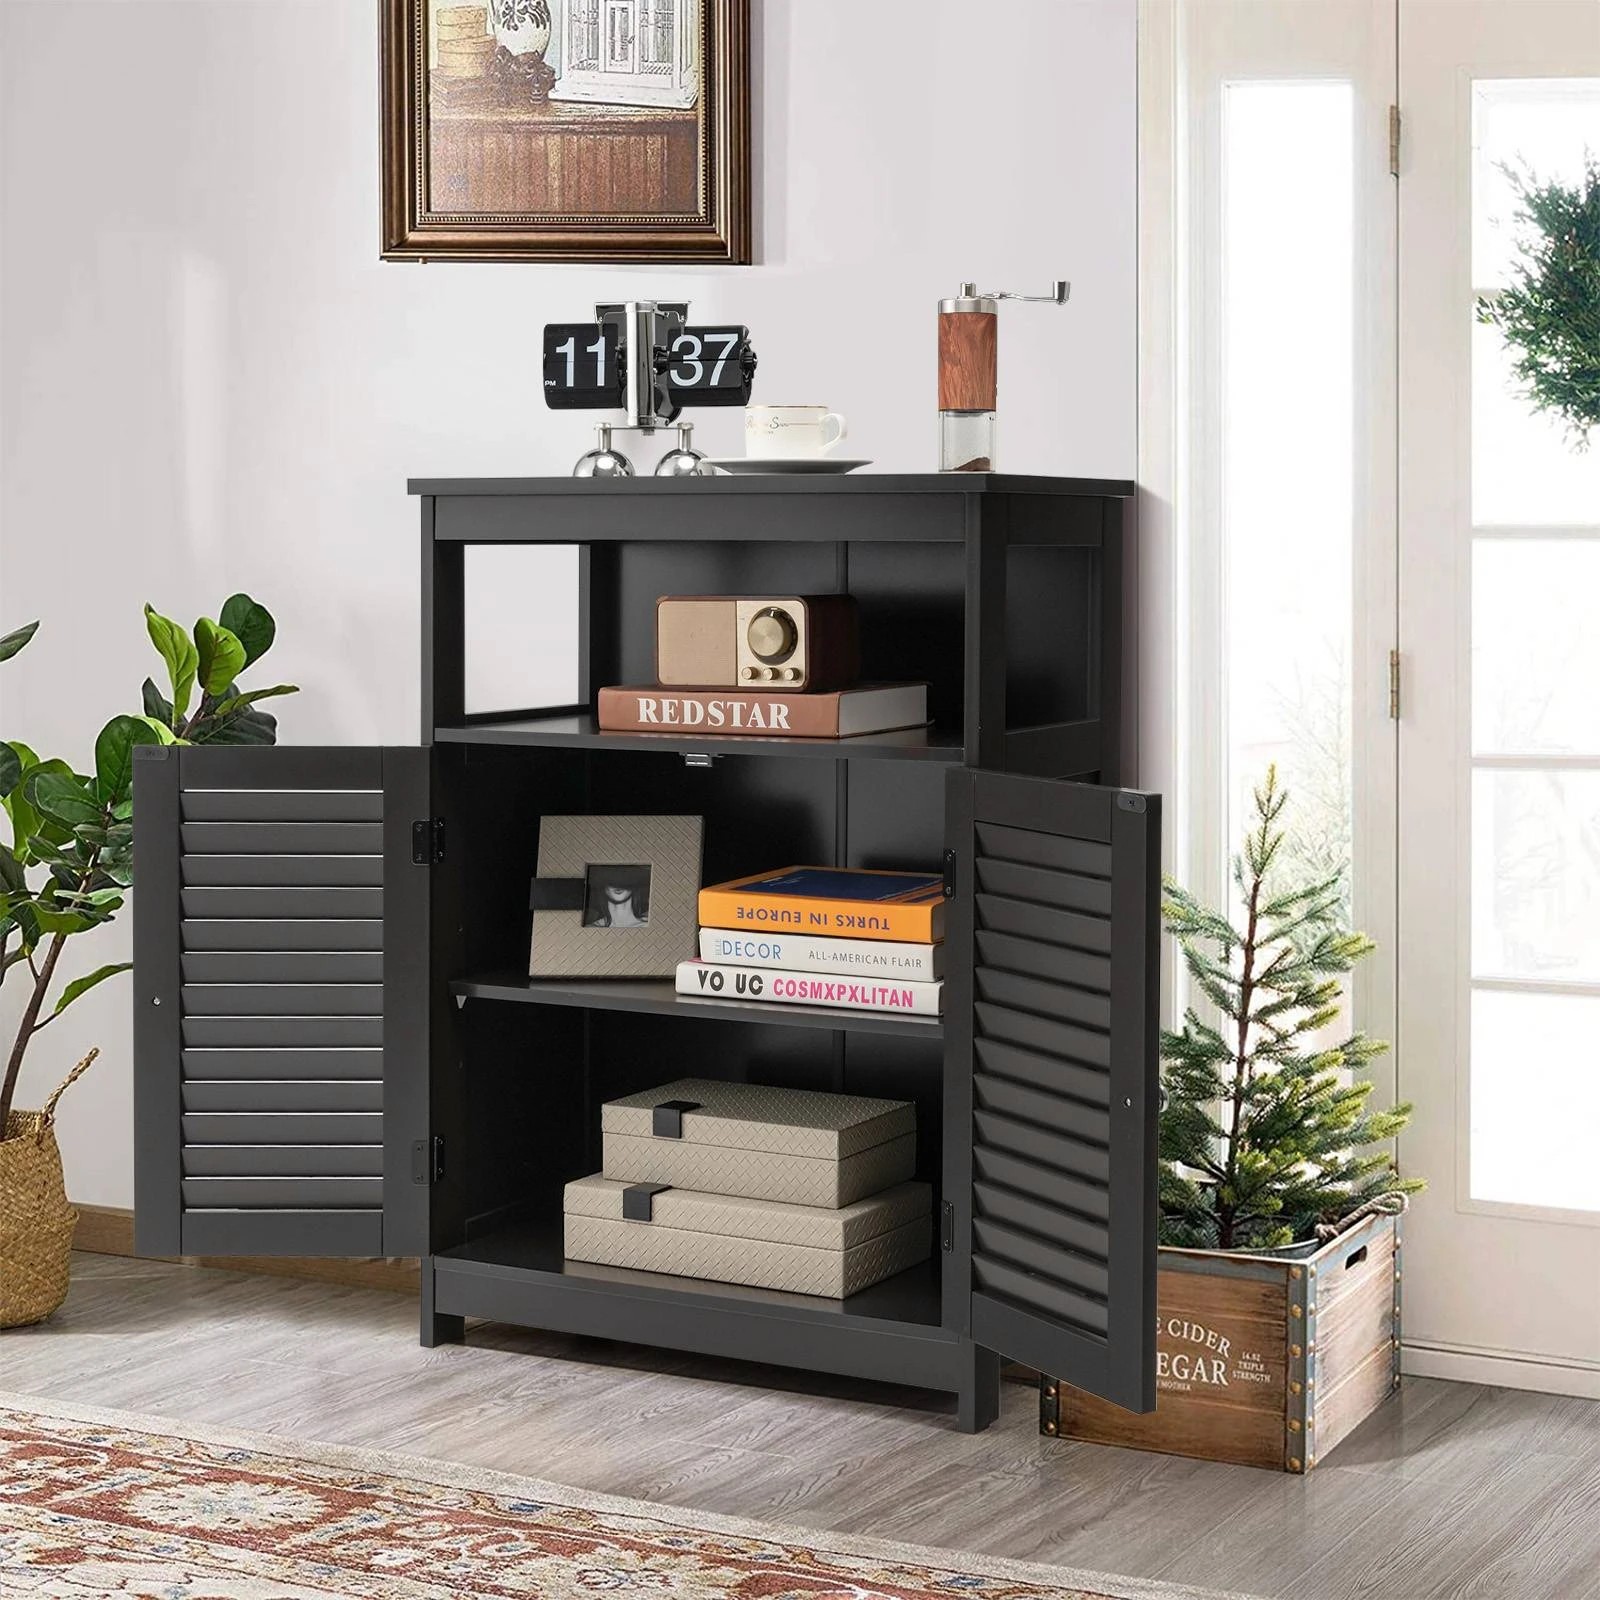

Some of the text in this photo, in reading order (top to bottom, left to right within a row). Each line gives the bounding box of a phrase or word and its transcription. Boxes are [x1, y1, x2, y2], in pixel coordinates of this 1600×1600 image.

[555, 333, 739, 387] 11 37
[637, 697, 791, 730] REDSTAR
[737, 907, 890, 930] TURKS IN EUROPE
[722, 940, 782, 960] DECOR
[808, 950, 922, 968] ALL-AMERICAN FLAIR
[697, 969, 725, 992] VO
[773, 978, 914, 1008] COSMXPXLITAN
[1167, 1318, 1231, 1358] CIDER
[1232, 1370, 1271, 1383] STRENGTH
[1238, 1360, 1265, 1372] TRIPLE
